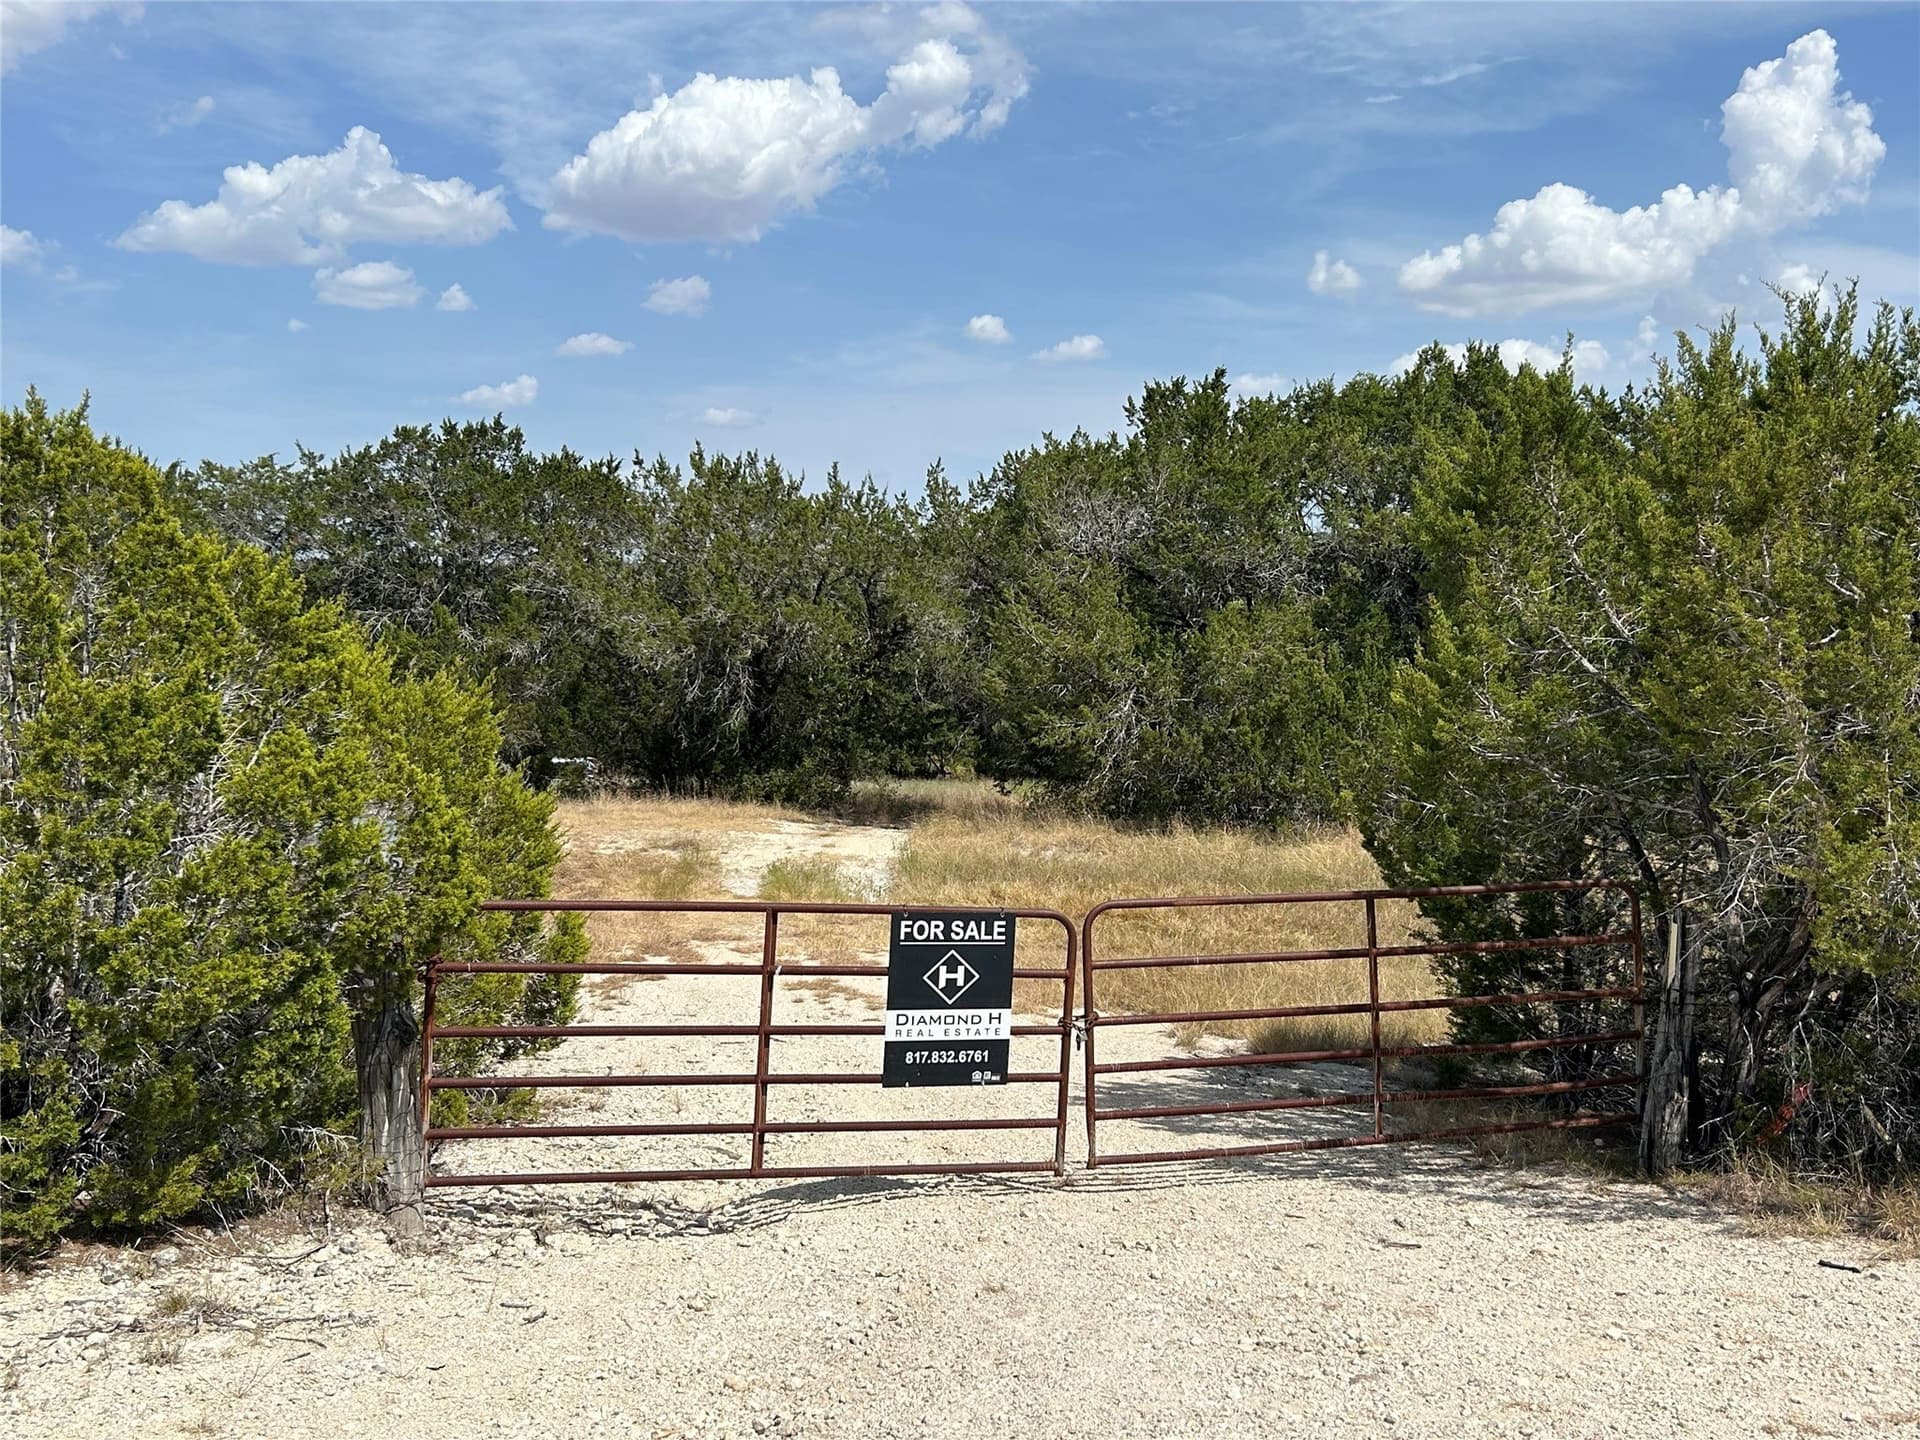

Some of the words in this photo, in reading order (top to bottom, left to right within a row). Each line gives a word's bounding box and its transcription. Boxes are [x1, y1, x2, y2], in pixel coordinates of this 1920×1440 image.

[900, 920, 945, 940] FOR
[950, 920, 1006, 940] SALE
[938, 965, 965, 989] H
[896, 1013, 982, 1026] DIAMOND
[988, 1012, 1002, 1025] H
[895, 1028, 935, 1037] REAL
[943, 1027, 1001, 1037] ESTATE
[905, 1049, 989, 1064] 817.832.6761
